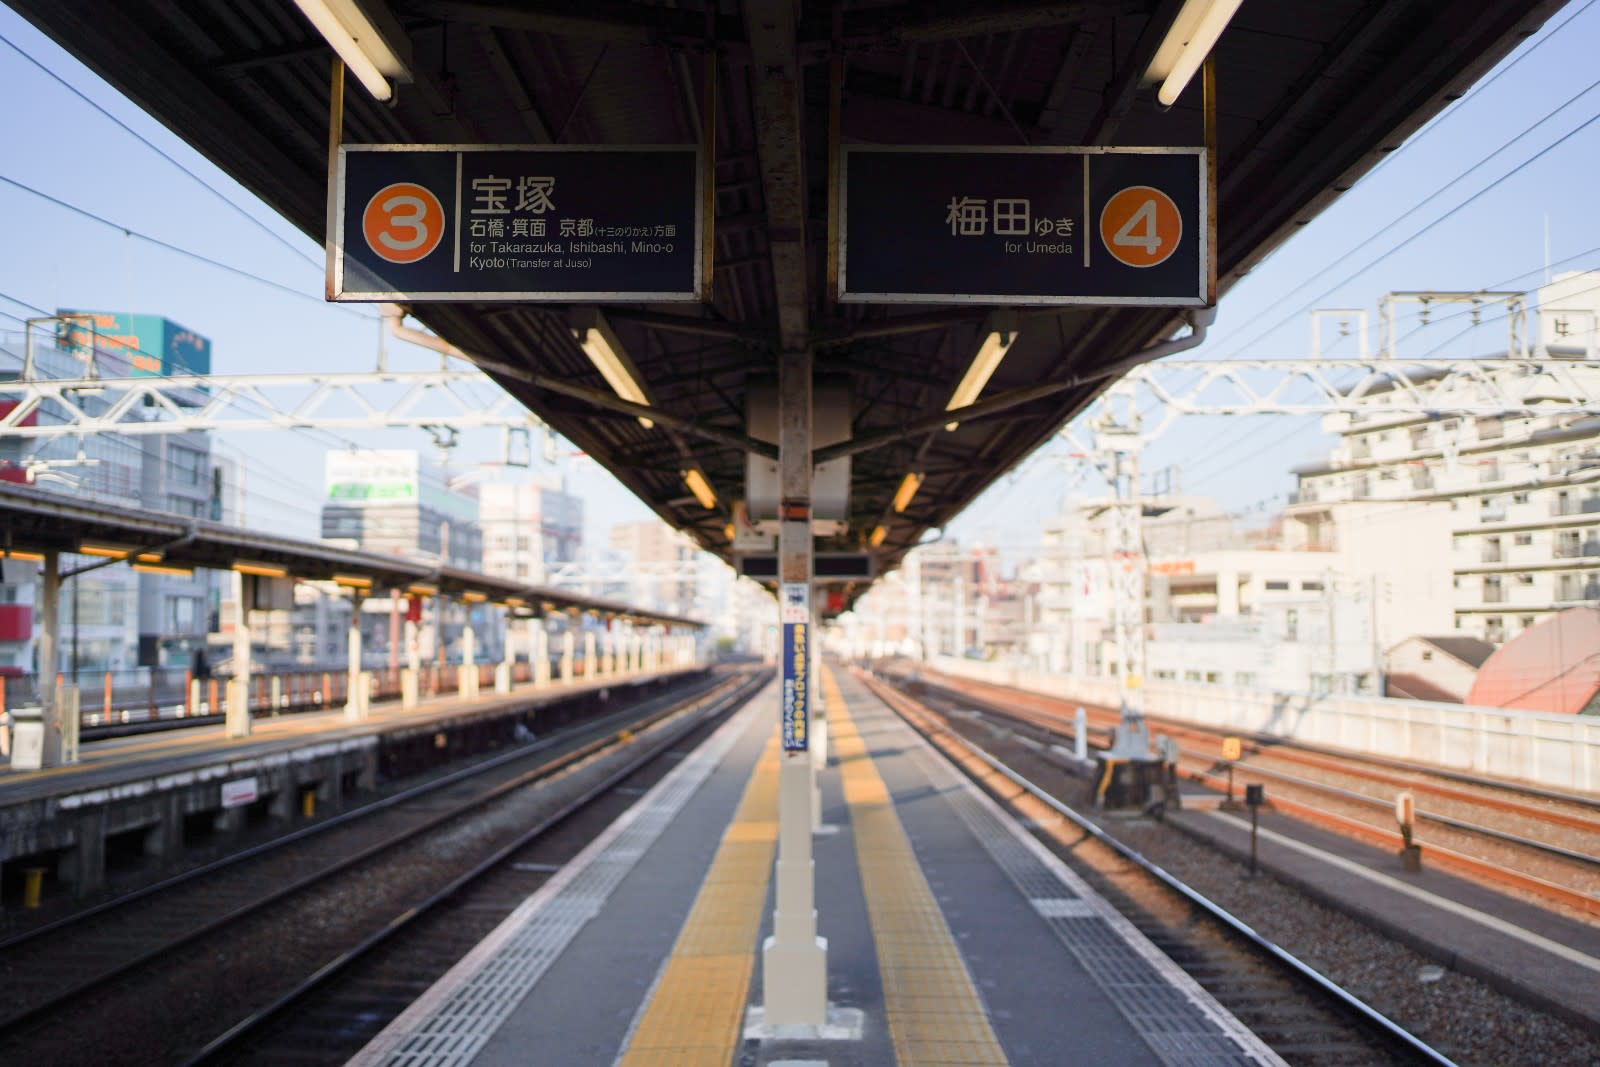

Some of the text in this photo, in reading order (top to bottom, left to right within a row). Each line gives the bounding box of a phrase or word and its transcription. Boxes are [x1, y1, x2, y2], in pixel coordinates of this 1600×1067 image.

[470, 174, 556, 214] 宝塚
[378, 195, 429, 251] 3
[1113, 199, 1163, 255] 4
[470, 241, 674, 255] for Takarazuka, Ishibashi, Mino-o
[1004, 240, 1073, 254] for Umeda
[553, 258, 563, 268] at
[565, 258, 592, 269] Juso)
